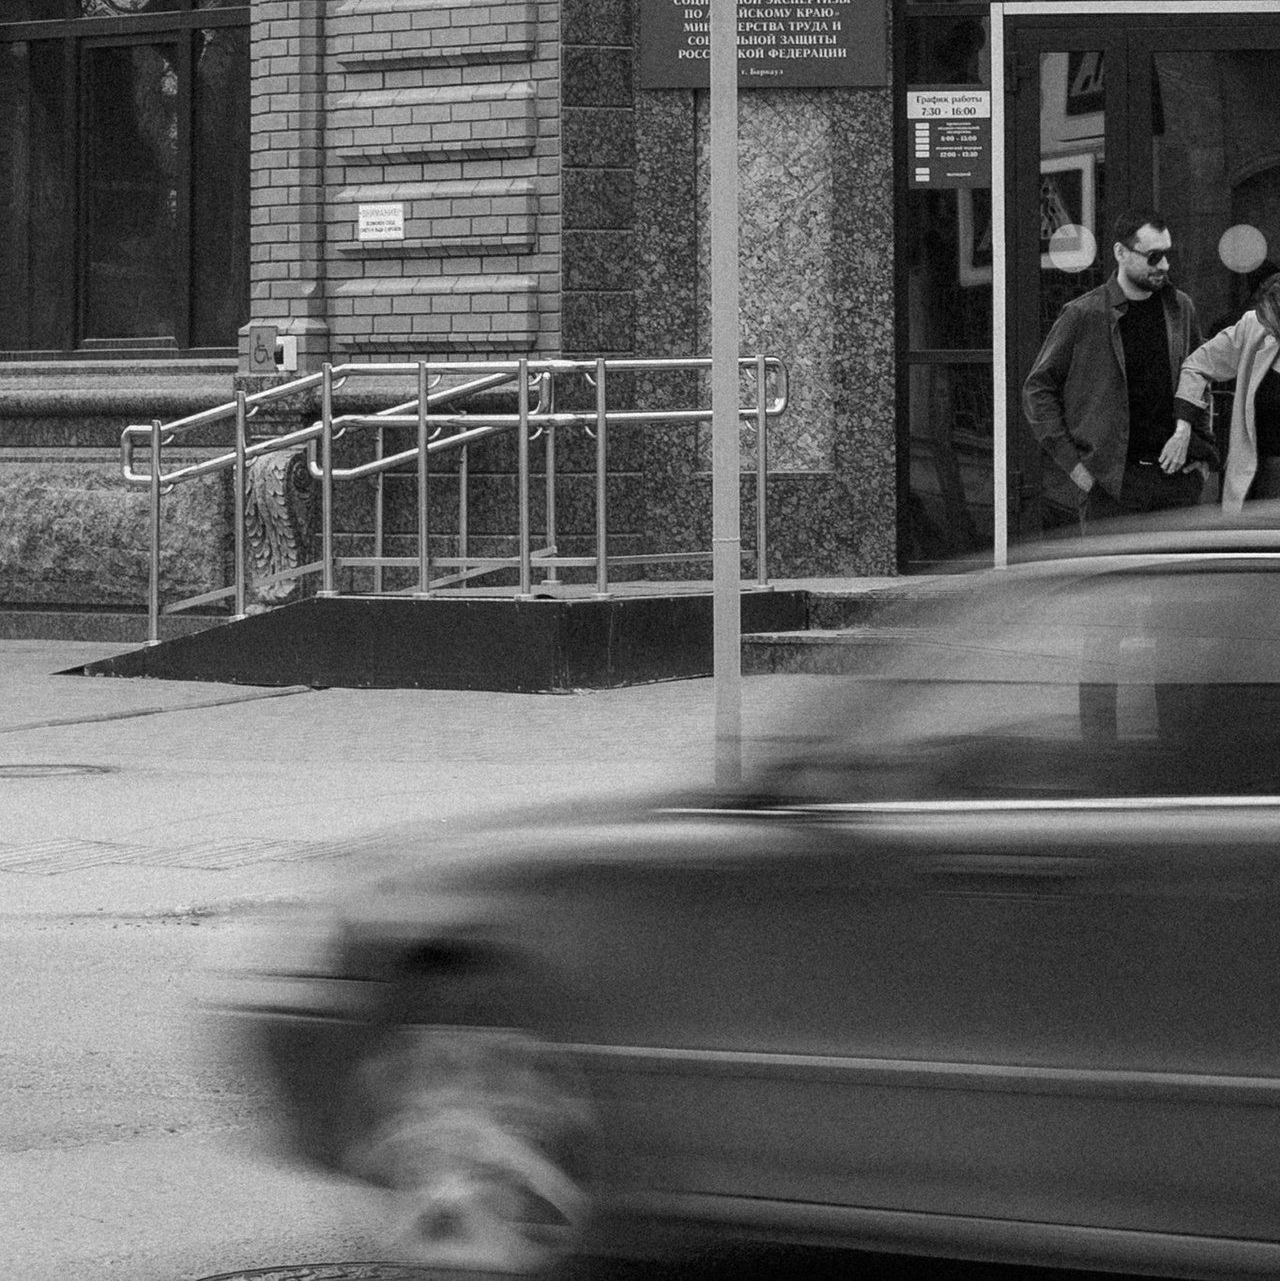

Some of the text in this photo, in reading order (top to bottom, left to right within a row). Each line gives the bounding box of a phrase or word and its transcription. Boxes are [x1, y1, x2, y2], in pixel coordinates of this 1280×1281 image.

[684, 8, 702, 19] ПО
[706, 7, 793, 19] ЙСКОМУ
[683, 21, 842, 32] МИНЕРСТВА ТРУДА И
[780, 35, 837, 46] ЗАЩИТЫ
[678, 47, 847, 59] РОССКОЙ ФЕДЕРАЦИИ
[916, 95, 982, 105] График работы
[921, 107, 941, 116] 7:30
[952, 107, 976, 116] 16:00
